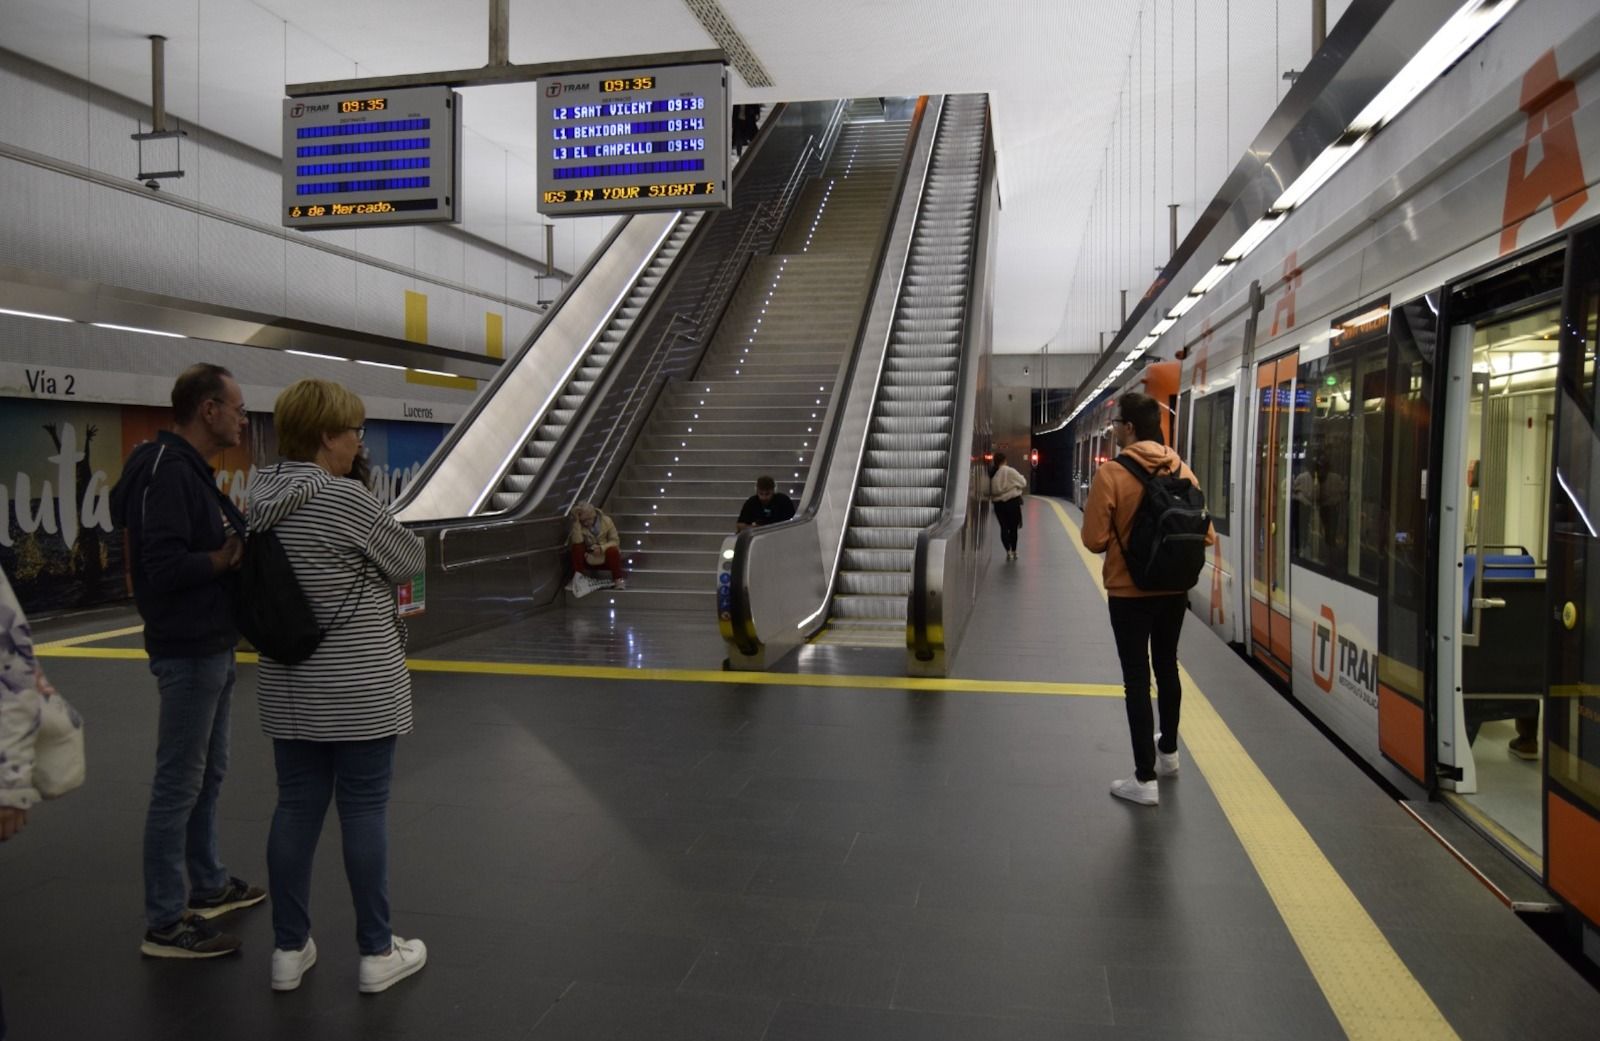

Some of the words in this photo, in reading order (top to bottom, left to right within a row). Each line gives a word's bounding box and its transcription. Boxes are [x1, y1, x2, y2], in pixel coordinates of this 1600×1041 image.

[562, 83, 590, 93] TRAM
[604, 78, 652, 92] 09:35
[342, 99, 385, 113] 09:35
[553, 108, 567, 120] L2
[574, 105, 602, 118] SANT
[609, 101, 653, 116] VICENT
[667, 98, 705, 112] 09:38
[553, 128, 567, 140] L1
[574, 123, 631, 138] BENIDORM
[667, 118, 705, 132] 09:41
[553, 148, 567, 160] L3
[574, 146, 588, 158] EL
[595, 142, 653, 157] CAMPELLO
[667, 138, 705, 152] 09:49
[574, 188, 594, 201] IN
[602, 186, 641, 200] YOUR
[648, 183, 697, 196] SIGHT
[307, 205, 325, 217] de
[331, 202, 396, 215] Mercado.
[25, 369, 57, 394] Vía
[64, 374, 76, 395] 2
[403, 402, 433, 419] Luceros
